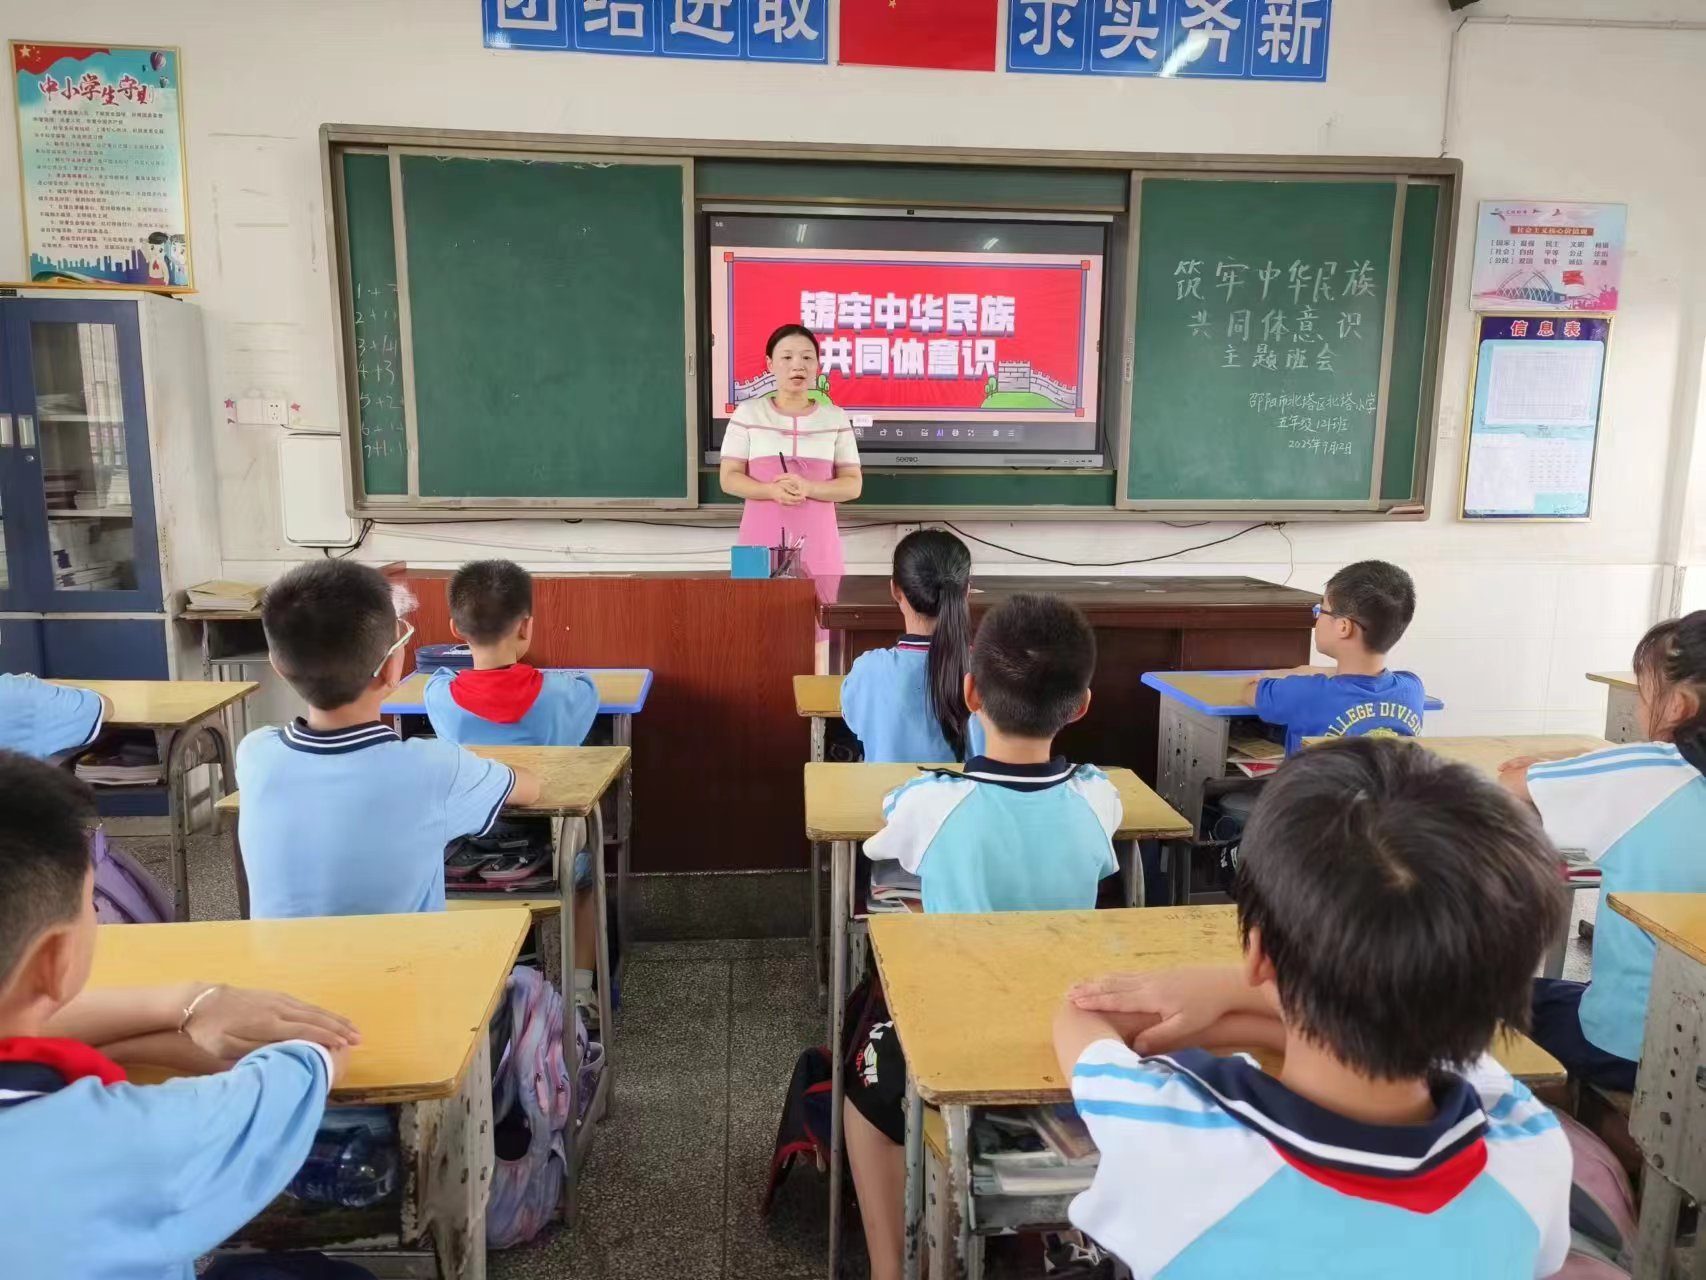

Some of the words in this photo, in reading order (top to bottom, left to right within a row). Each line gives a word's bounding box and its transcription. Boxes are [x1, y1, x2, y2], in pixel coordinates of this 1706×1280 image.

[1020, 0, 1322, 65] 求实务新
[39, 73, 154, 105] 中小学生守则
[1173, 256, 1377, 304] 筑牢中华民族
[1187, 305, 1362, 343] 共同体意识
[1511, 320, 1581, 337] 信息表
[819, 336, 996, 379] 共同体意识
[1221, 343, 1336, 372] 主题班会
[1324, 703, 1376, 737] LLEGE
[1379, 702, 1425, 737] DIVISI
